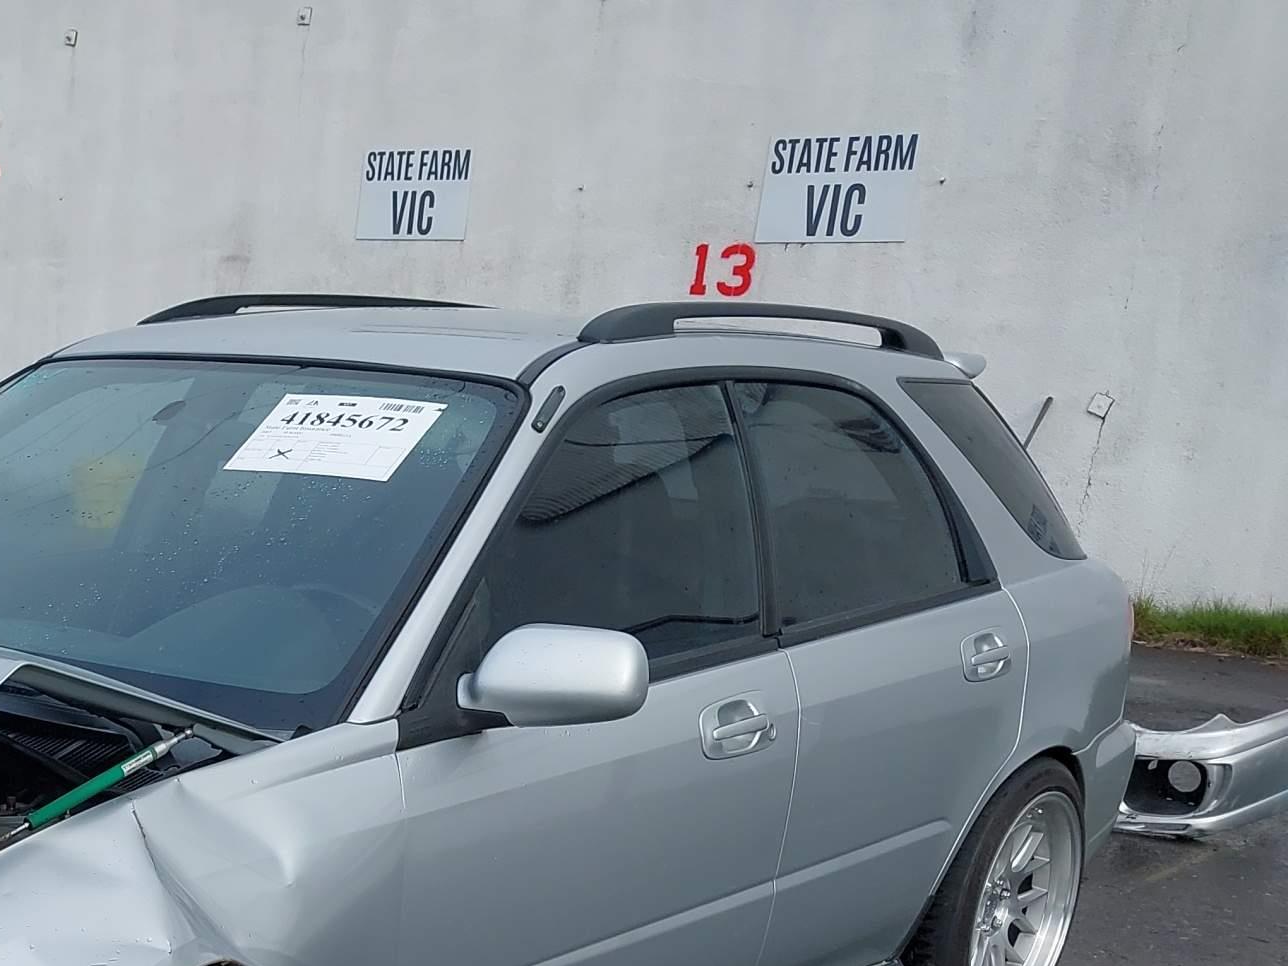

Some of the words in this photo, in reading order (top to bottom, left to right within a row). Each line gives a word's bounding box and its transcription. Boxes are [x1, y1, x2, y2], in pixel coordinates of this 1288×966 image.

[365, 150, 415, 182] STATE
[418, 149, 472, 181] FARM
[771, 137, 841, 175] STATE
[844, 133, 919, 173] FARM
[392, 190, 435, 236] VIC
[805, 182, 867, 237] VIC
[689, 243, 757, 297] 13
[280, 410, 410, 432] 41845672
